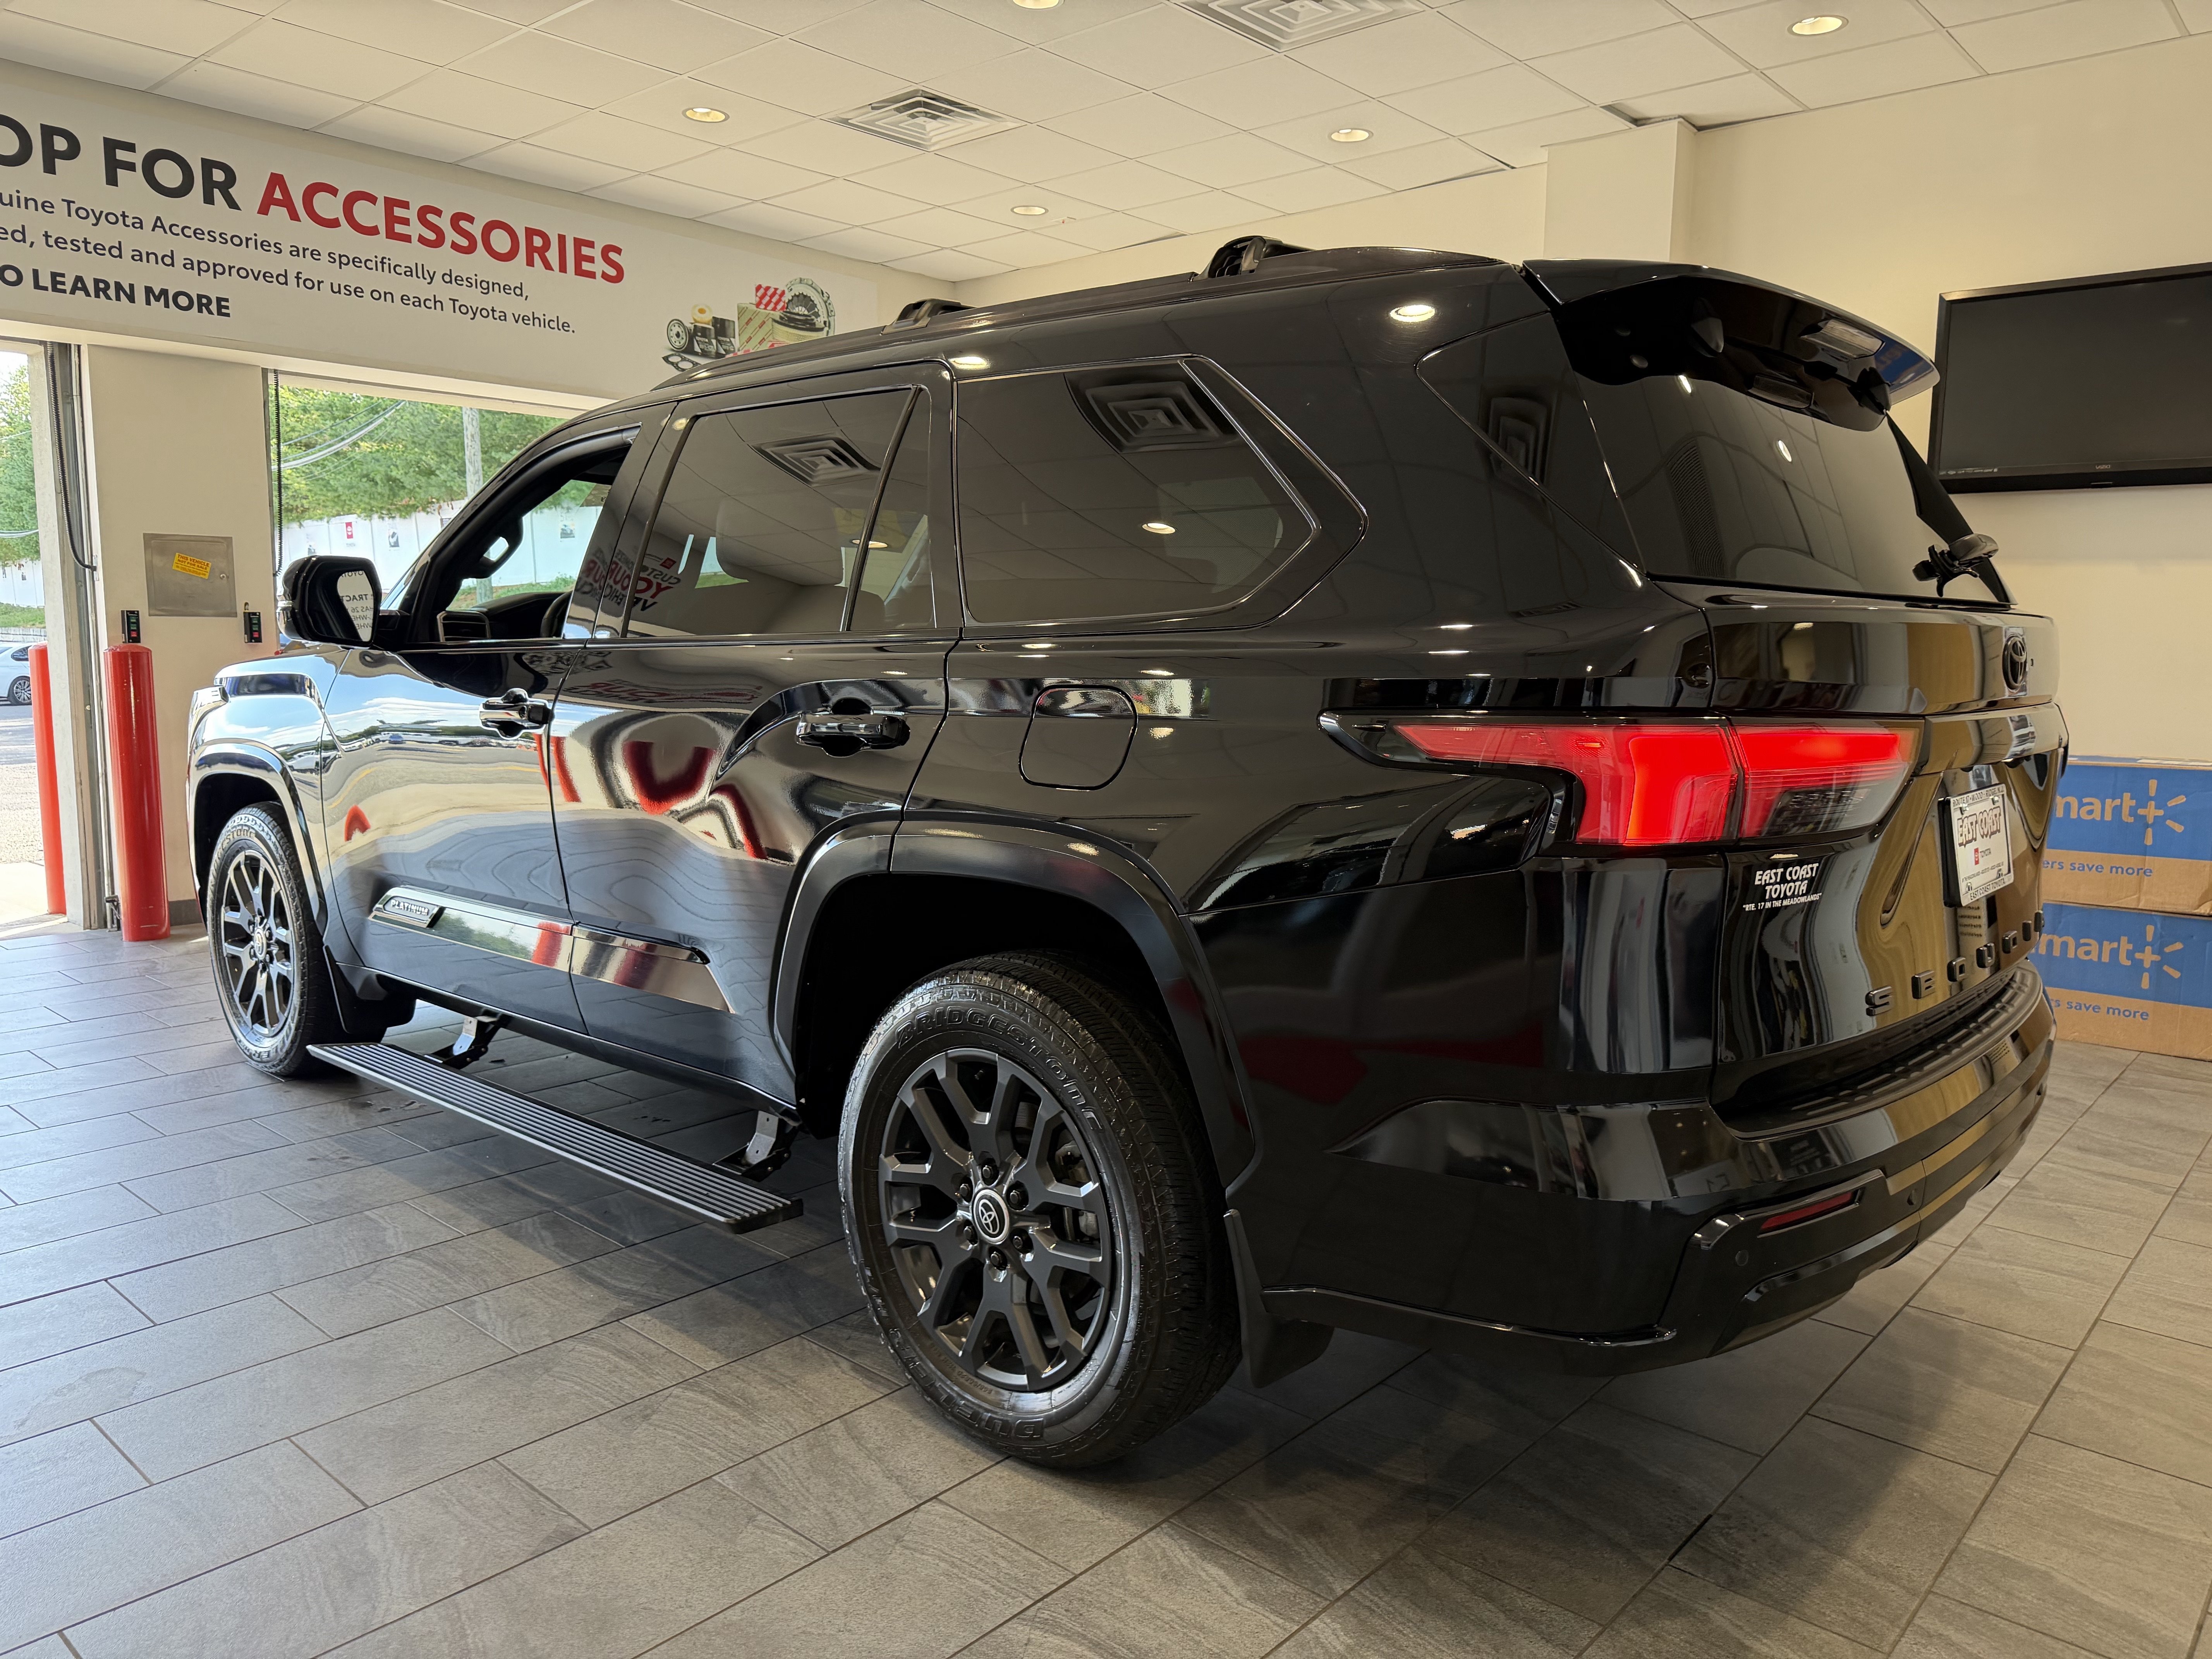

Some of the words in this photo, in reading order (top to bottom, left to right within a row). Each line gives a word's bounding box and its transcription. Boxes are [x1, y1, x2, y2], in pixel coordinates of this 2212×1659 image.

[103, 136, 242, 211] FOR
[257, 172, 625, 284] ACCESSORIES
[0, 189, 55, 214] uine
[61, 199, 144, 230] Toyota
[151, 216, 283, 254] Accessories
[289, 244, 321, 261] are
[328, 251, 437, 284] specifically
[441, 269, 529, 301] designed,
[32, 268, 136, 304] LEARN
[144, 285, 231, 318] MORE
[43, 230, 122, 259] tested
[131, 249, 174, 268] and
[182, 255, 288, 287] approved
[295, 271, 323, 291] for
[330, 283, 364, 298] use
[370, 288, 394, 304] on
[400, 294, 443, 311] each
[449, 298, 507, 322] Toyota
[513, 312, 575, 333] vehicle.
[189, 557, 210, 567] VEHICLE
[1957, 813, 1978, 848] EAST
[1978, 806, 2001, 840] COAST
[1754, 868, 1784, 886] EAST
[1786, 863, 1819, 881] COAST
[2069, 862, 2104, 873] save
[2110, 865, 2153, 877] more
[1765, 880, 1808, 899] TOYOTA
[1970, 890, 1979, 900] EAST
[391, 899, 429, 916] PLATINUM
[2030, 933, 2133, 966] mart
[2066, 1001, 2101, 1013] save
[2107, 1006, 2149, 1021] more
